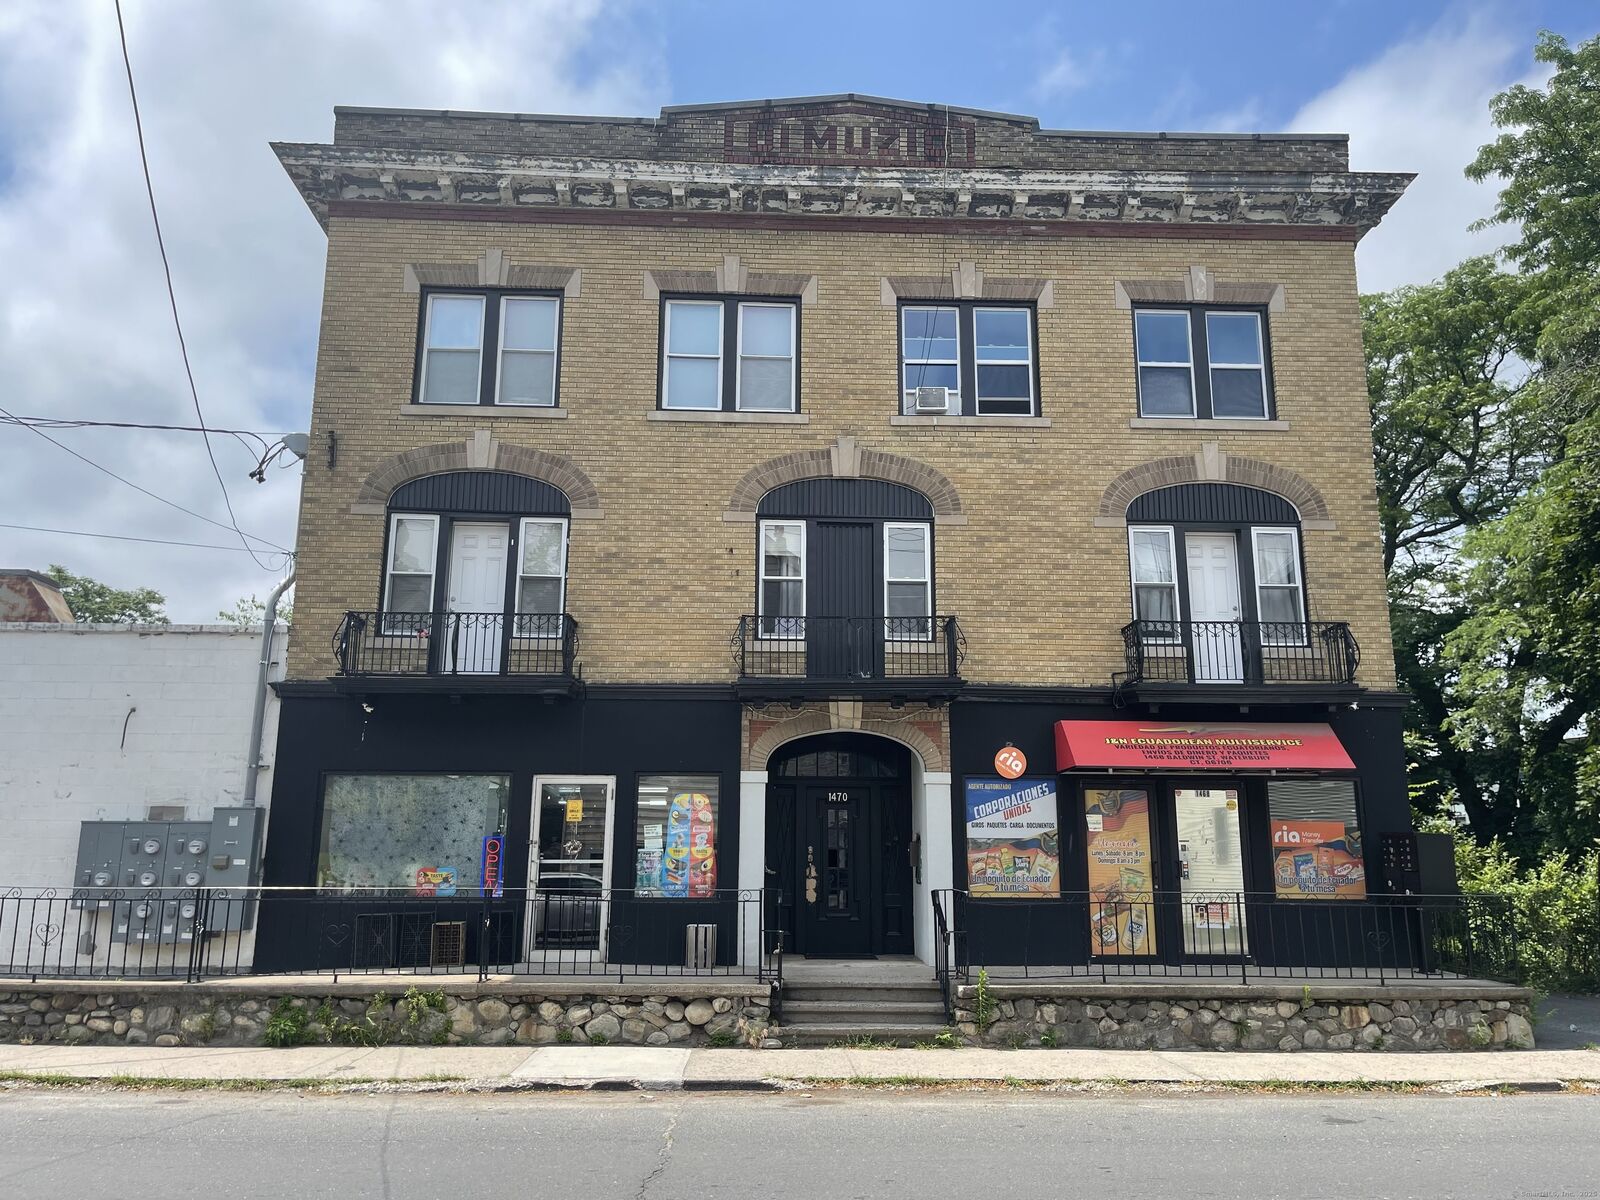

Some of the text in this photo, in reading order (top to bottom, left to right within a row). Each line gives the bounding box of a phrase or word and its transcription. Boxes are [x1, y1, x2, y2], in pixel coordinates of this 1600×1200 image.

[1215, 738, 1303, 746] MULTISERVICE
[999, 751, 1023, 772] ria
[828, 792, 848, 801] 1470
[973, 782, 1050, 819] CORPORACIONES
[1003, 802, 1032, 820] UNIDAS
[1274, 825, 1301, 843] ria
[1011, 874, 1021, 883] de
[1022, 875, 1052, 883] Ecuador
